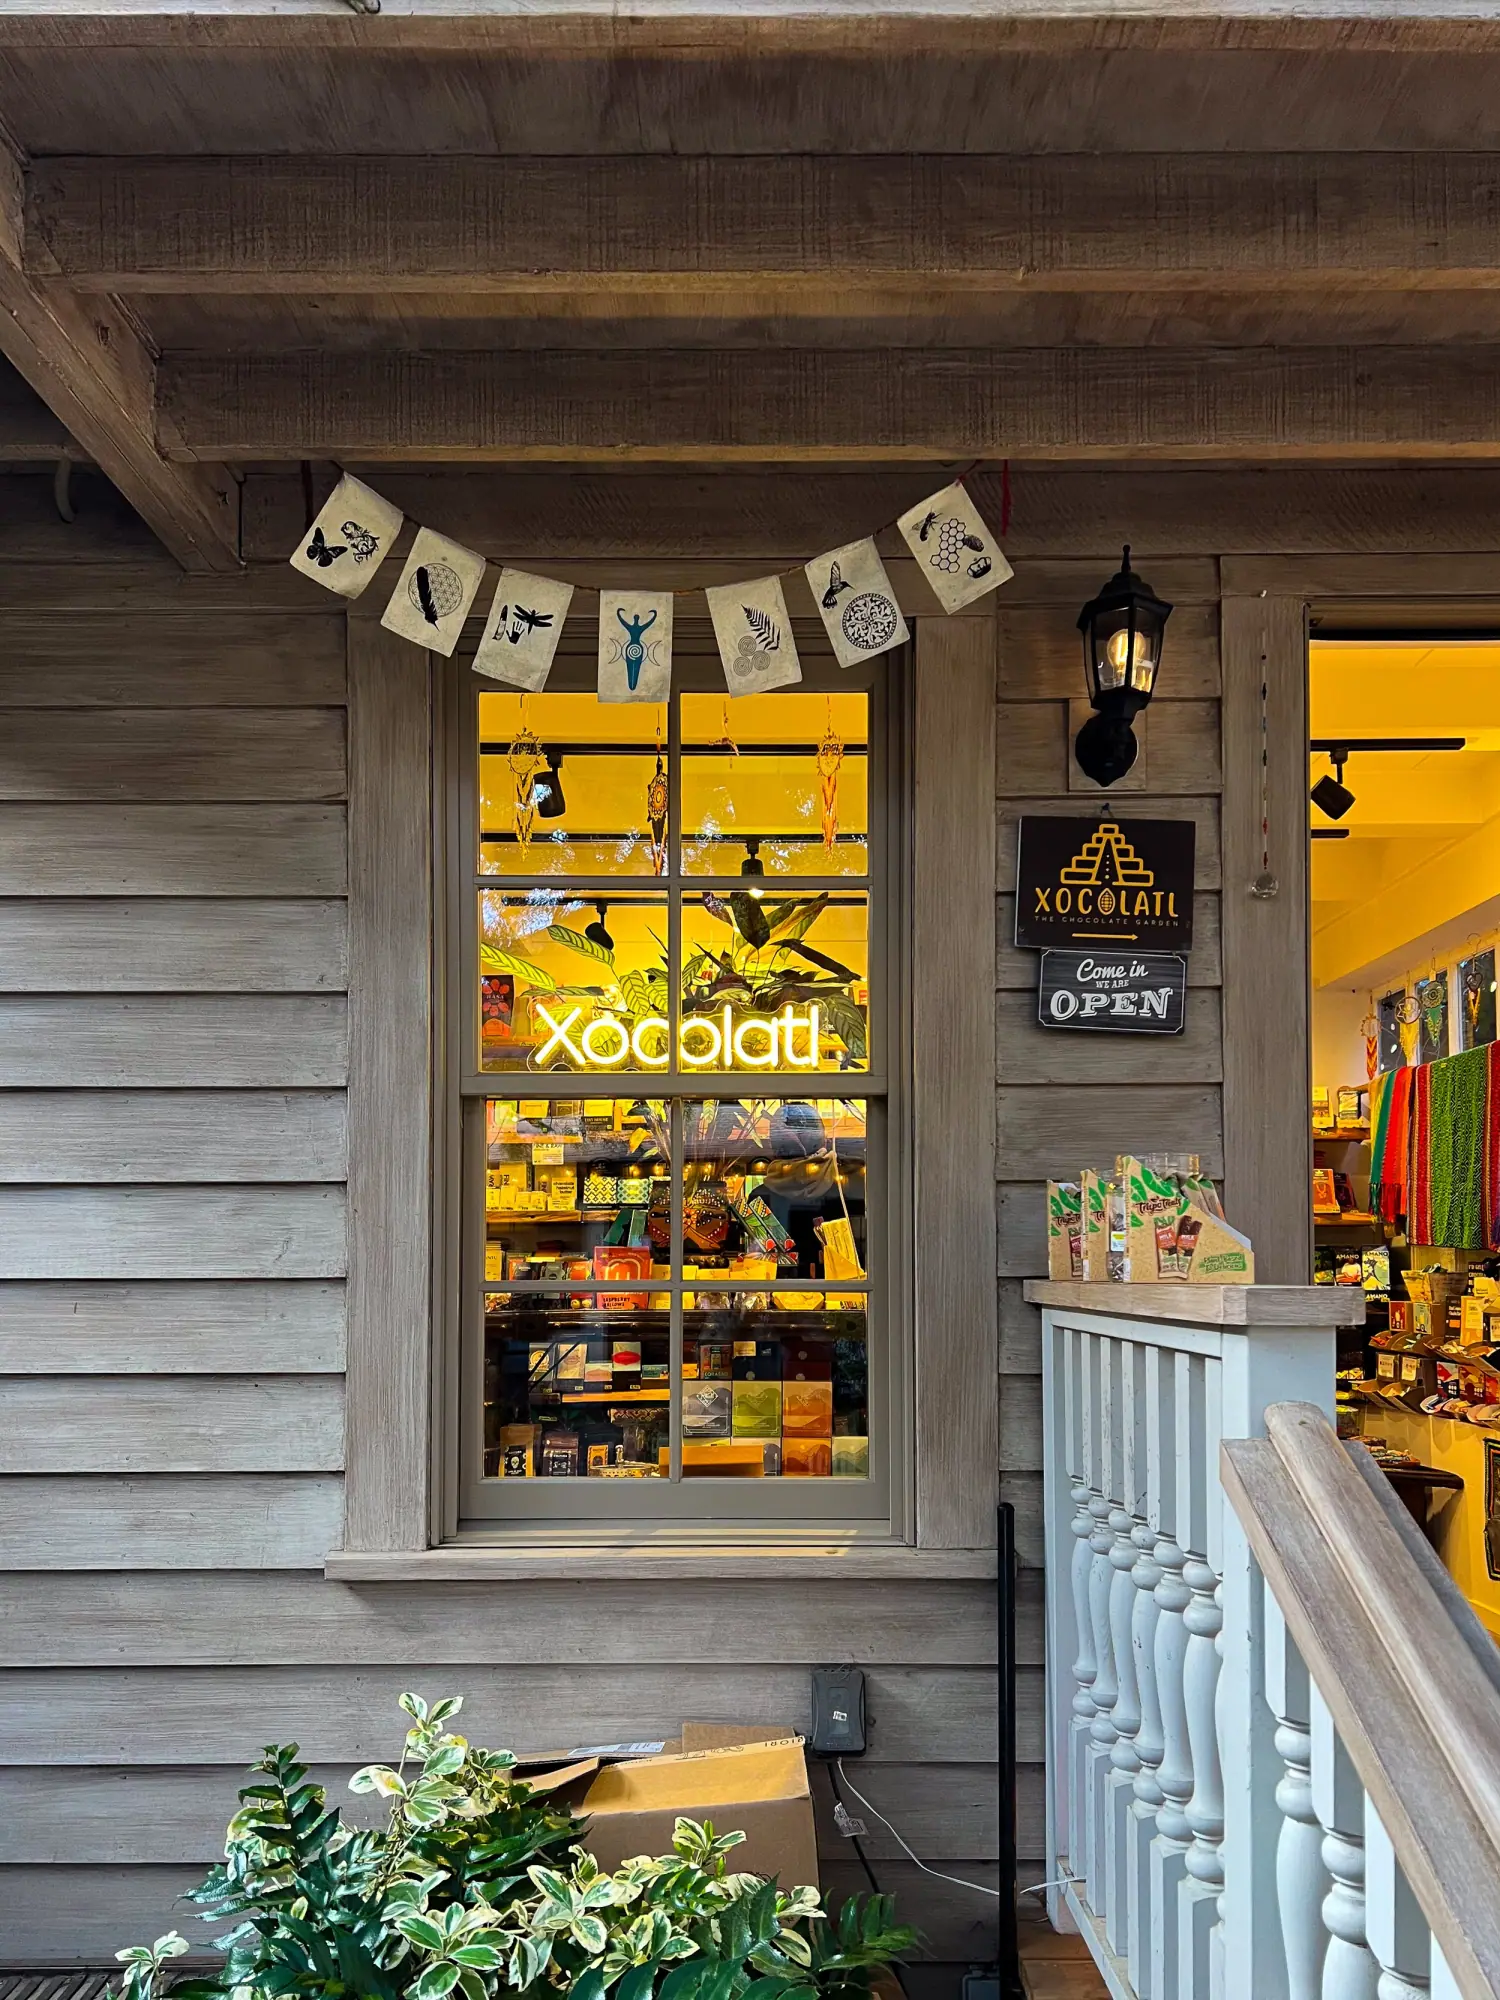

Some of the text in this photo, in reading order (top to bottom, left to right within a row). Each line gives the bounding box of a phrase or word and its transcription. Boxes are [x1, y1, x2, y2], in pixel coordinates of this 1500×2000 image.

[1035, 887, 1179, 917] XOCOLATL
[1062, 916, 1128, 925] CHOCOLATE
[1135, 919, 1179, 927] GARDEN
[1076, 958, 1149, 982] Come in
[1096, 980, 1129, 988] WE ARE
[1050, 987, 1173, 1020] OPEN
[534, 1003, 819, 1067] Xocolatl
